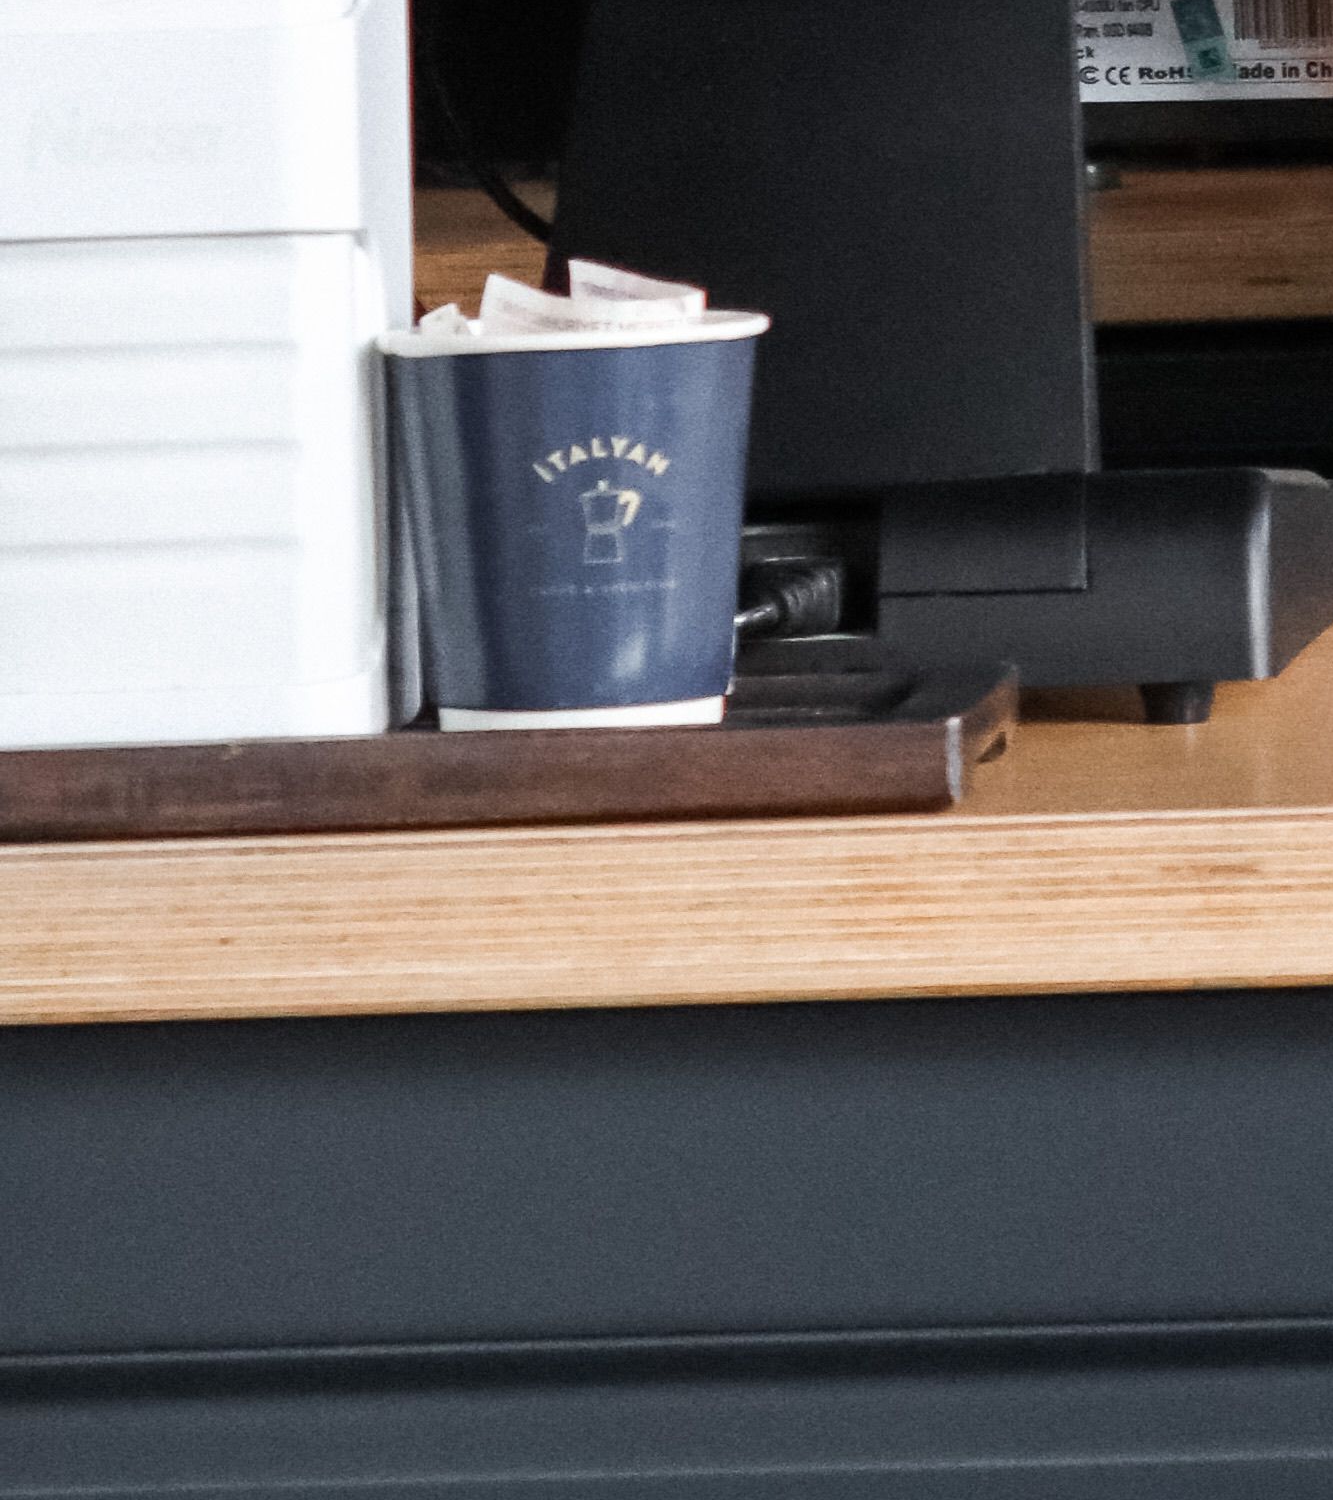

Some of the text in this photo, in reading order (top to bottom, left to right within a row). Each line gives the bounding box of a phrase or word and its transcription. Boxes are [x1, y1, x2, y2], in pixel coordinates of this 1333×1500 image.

[1231, 62, 1275, 80] ade
[1282, 62, 1300, 79] in
[532, 435, 671, 484] ITALYAN
